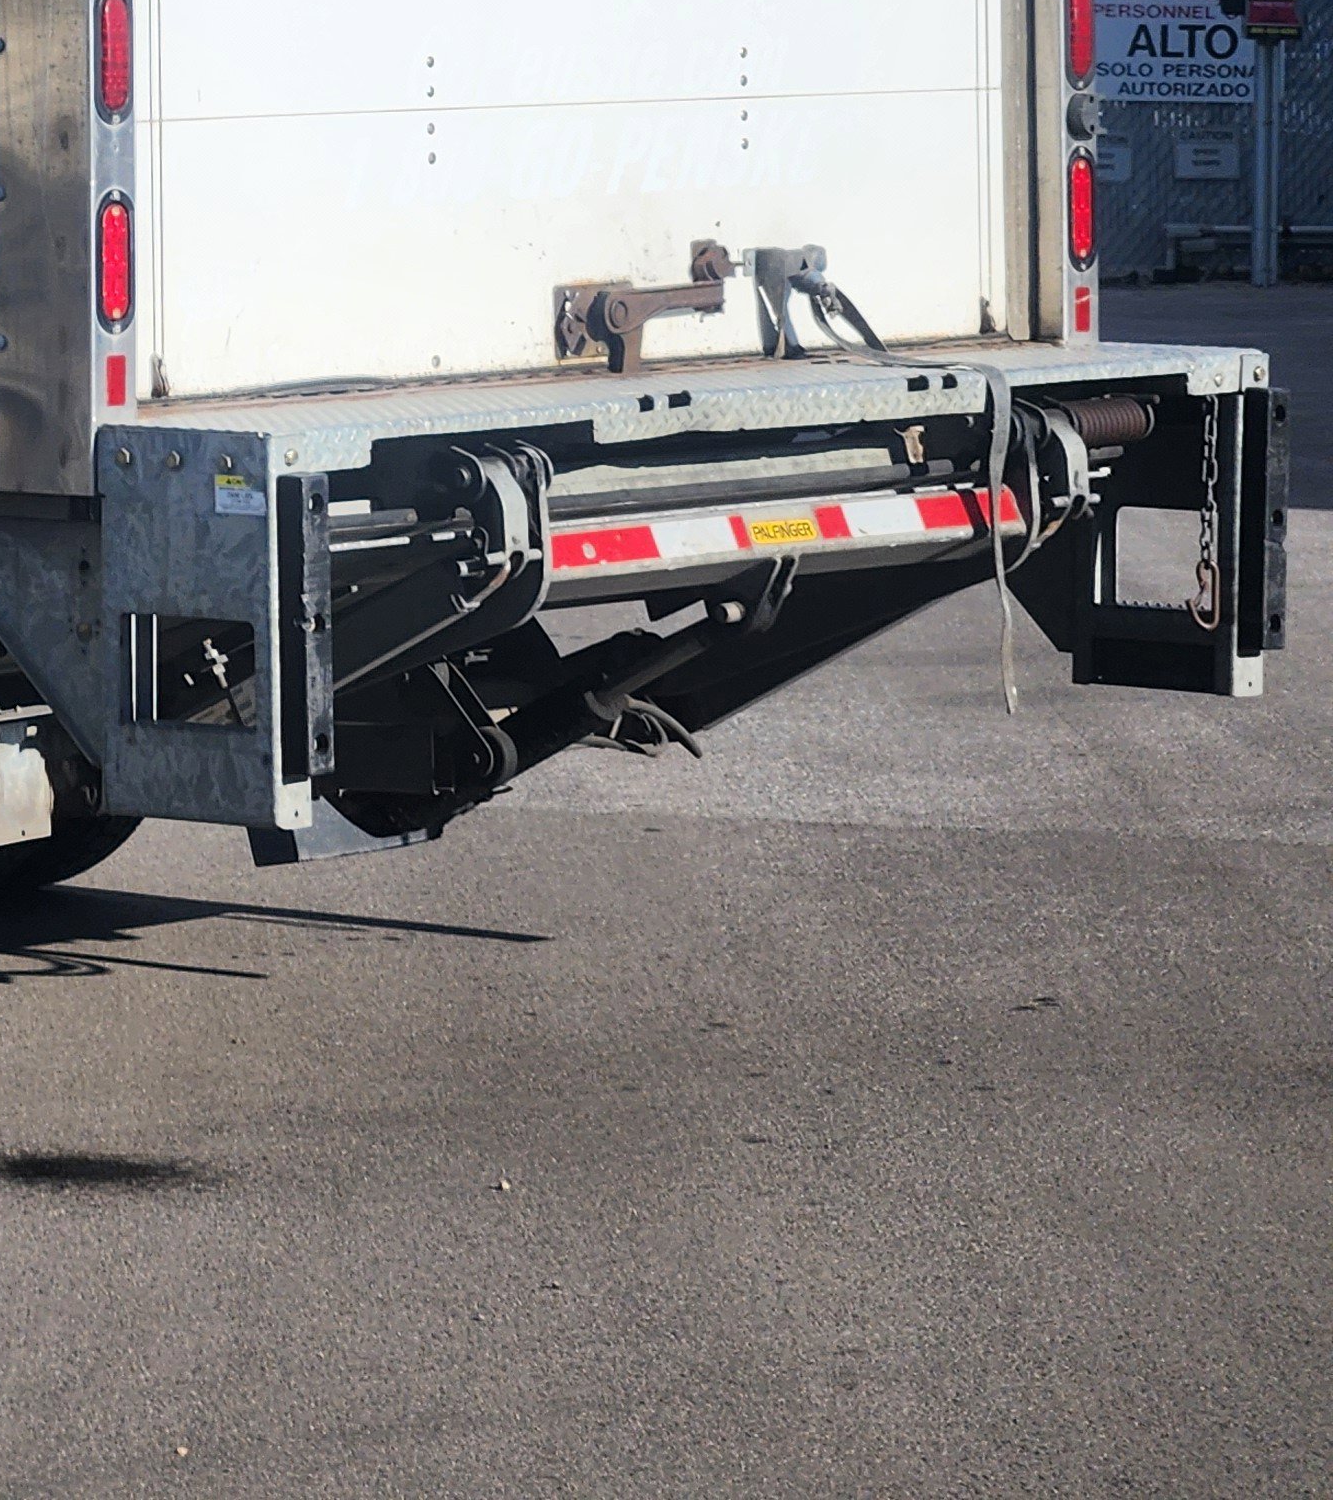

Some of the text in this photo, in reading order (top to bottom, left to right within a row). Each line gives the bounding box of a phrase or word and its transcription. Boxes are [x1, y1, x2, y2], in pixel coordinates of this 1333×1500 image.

[1094, 3, 1215, 20] PERSONNEL
[1127, 23, 1238, 60] ALTO
[1096, 62, 1153, 77] SOLO
[1118, 81, 1250, 98] AUTORIZADO
